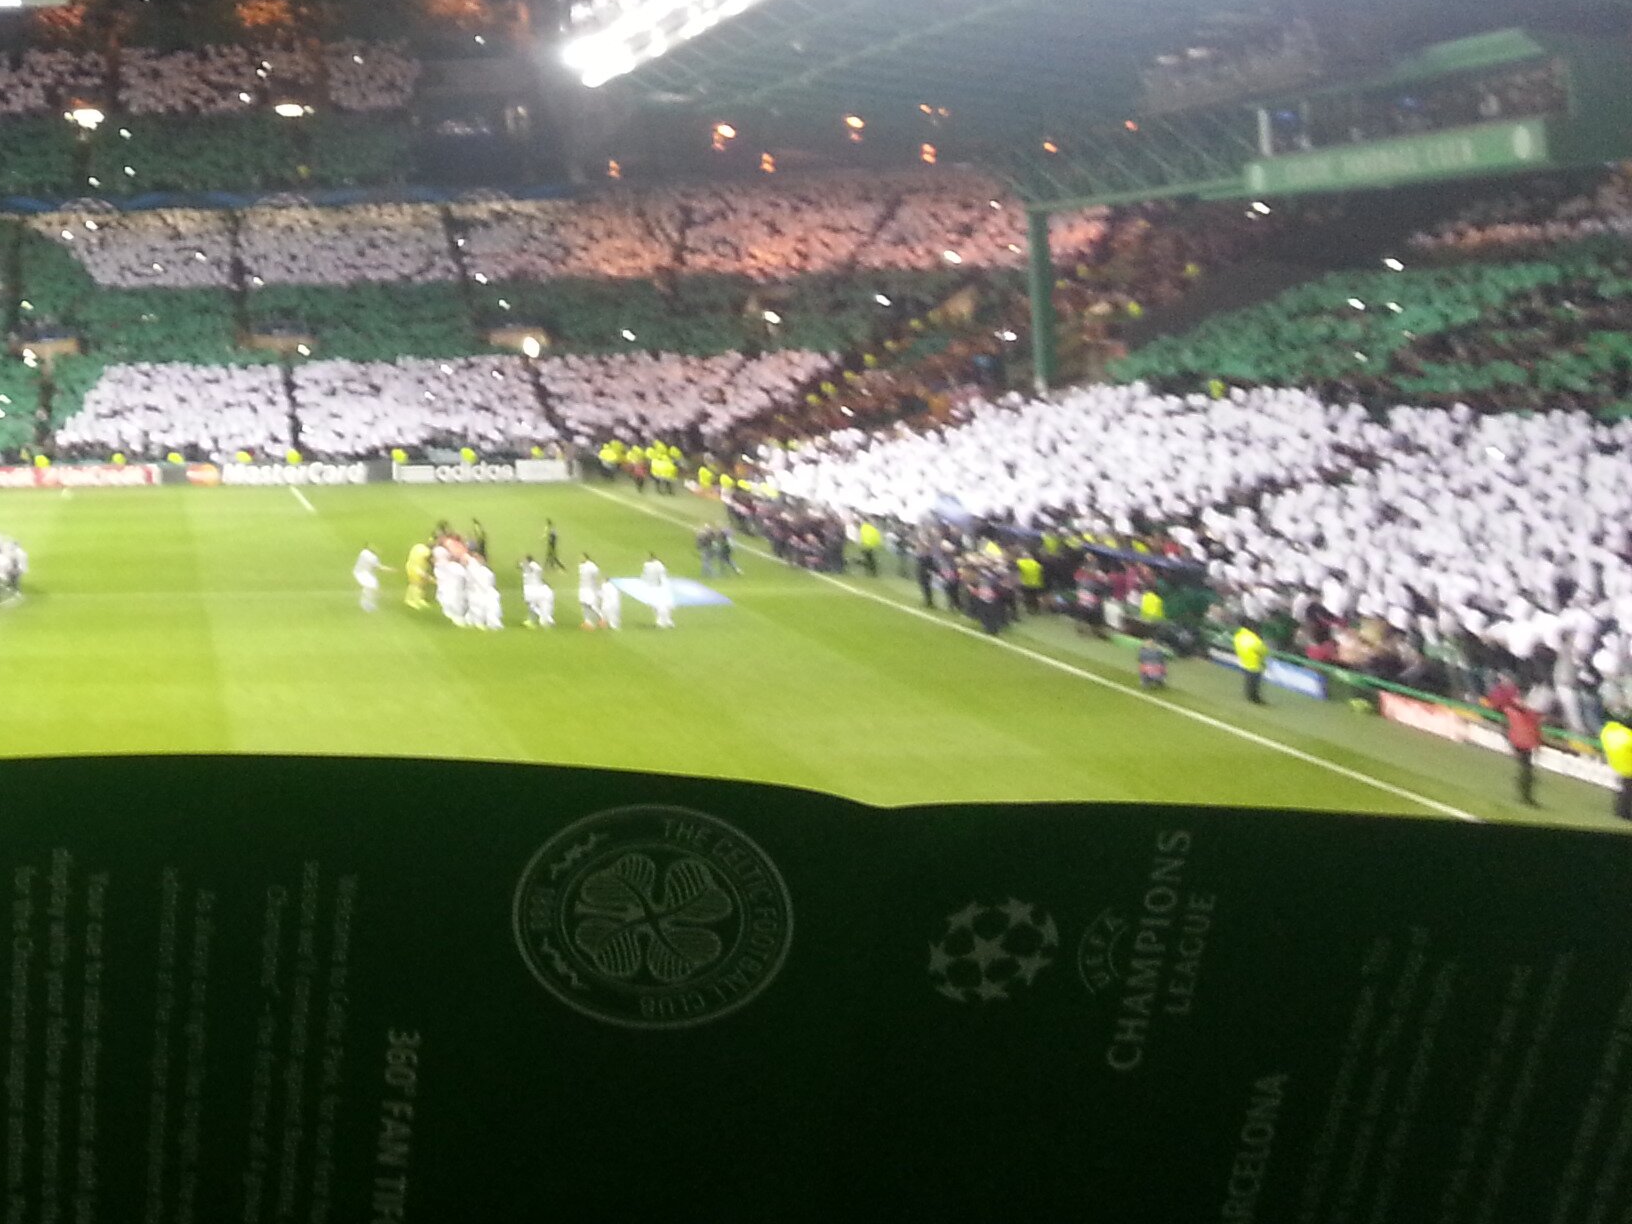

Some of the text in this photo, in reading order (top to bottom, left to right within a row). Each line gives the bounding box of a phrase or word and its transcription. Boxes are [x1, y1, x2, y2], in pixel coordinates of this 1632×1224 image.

[222, 461, 367, 484] MasterCard
[435, 460, 515, 482] adidas
[639, 818, 778, 1018] THE CELTIC FOOTBALL CLUB
[1086, 914, 1125, 989] UEFA
[1105, 830, 1192, 1072] CHAMPIONS
[1164, 891, 1217, 1016] LEAGUE
[376, 1100, 415, 1166] FAN
